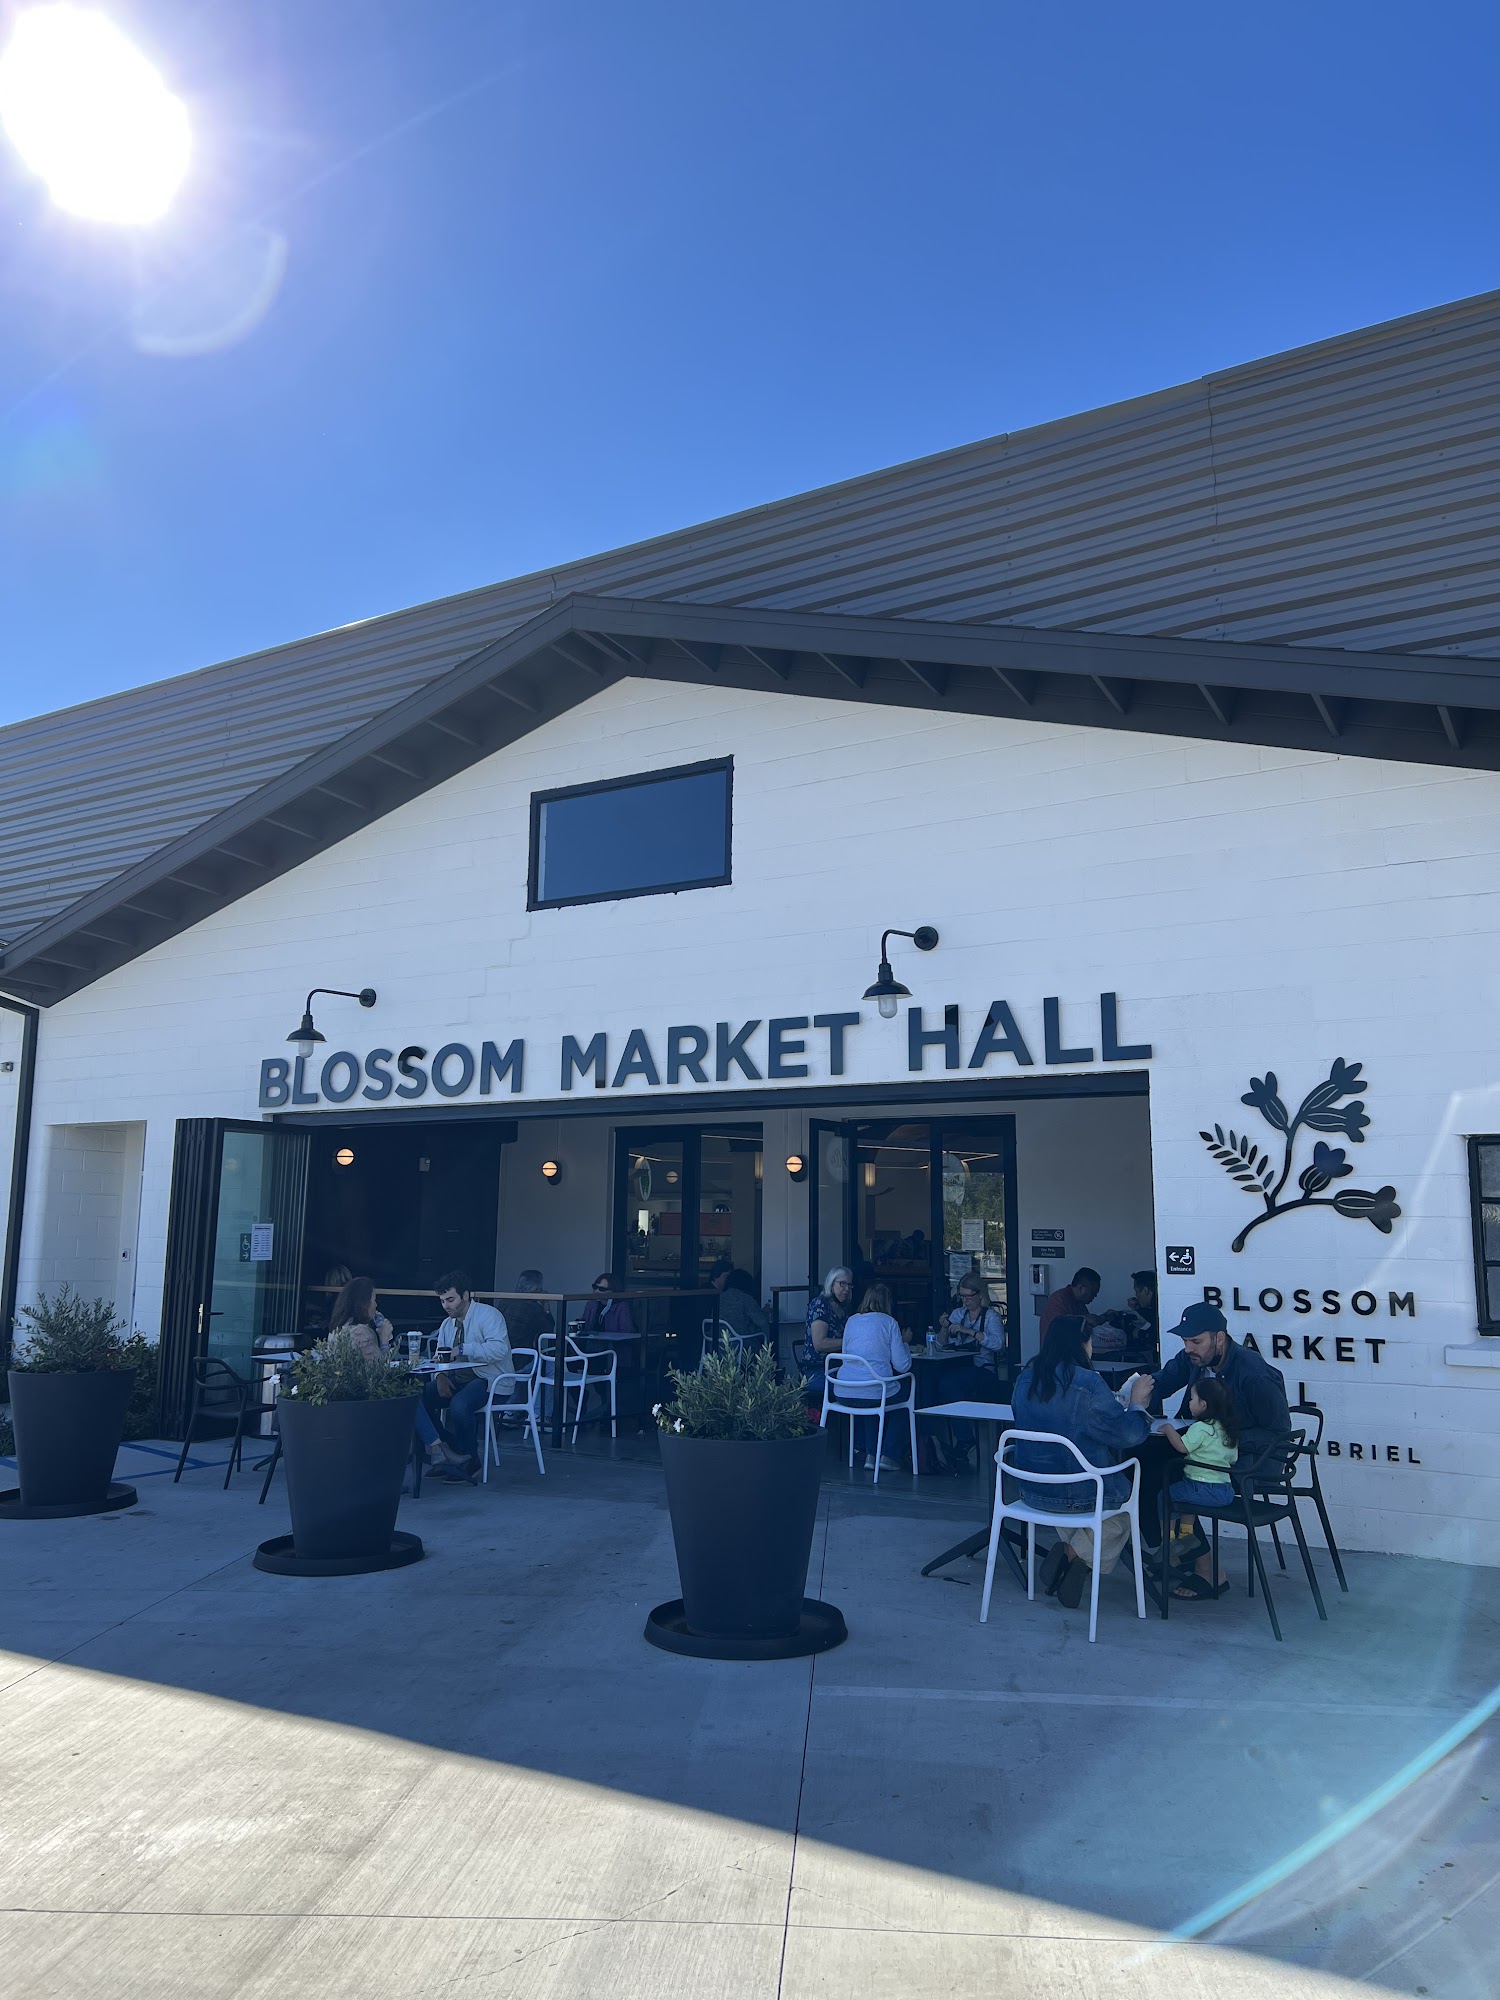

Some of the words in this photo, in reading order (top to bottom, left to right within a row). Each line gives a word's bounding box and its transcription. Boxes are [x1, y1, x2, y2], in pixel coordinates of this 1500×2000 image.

[258, 1038, 524, 1108] BLOSSOM
[560, 1012, 860, 1091] MARKET
[908, 992, 1153, 1071] HALL
[1203, 1286, 1416, 1317] BLOSSOM
[1243, 1332, 1386, 1364] ARKET
[1308, 1439, 1421, 1464] BRIEL
